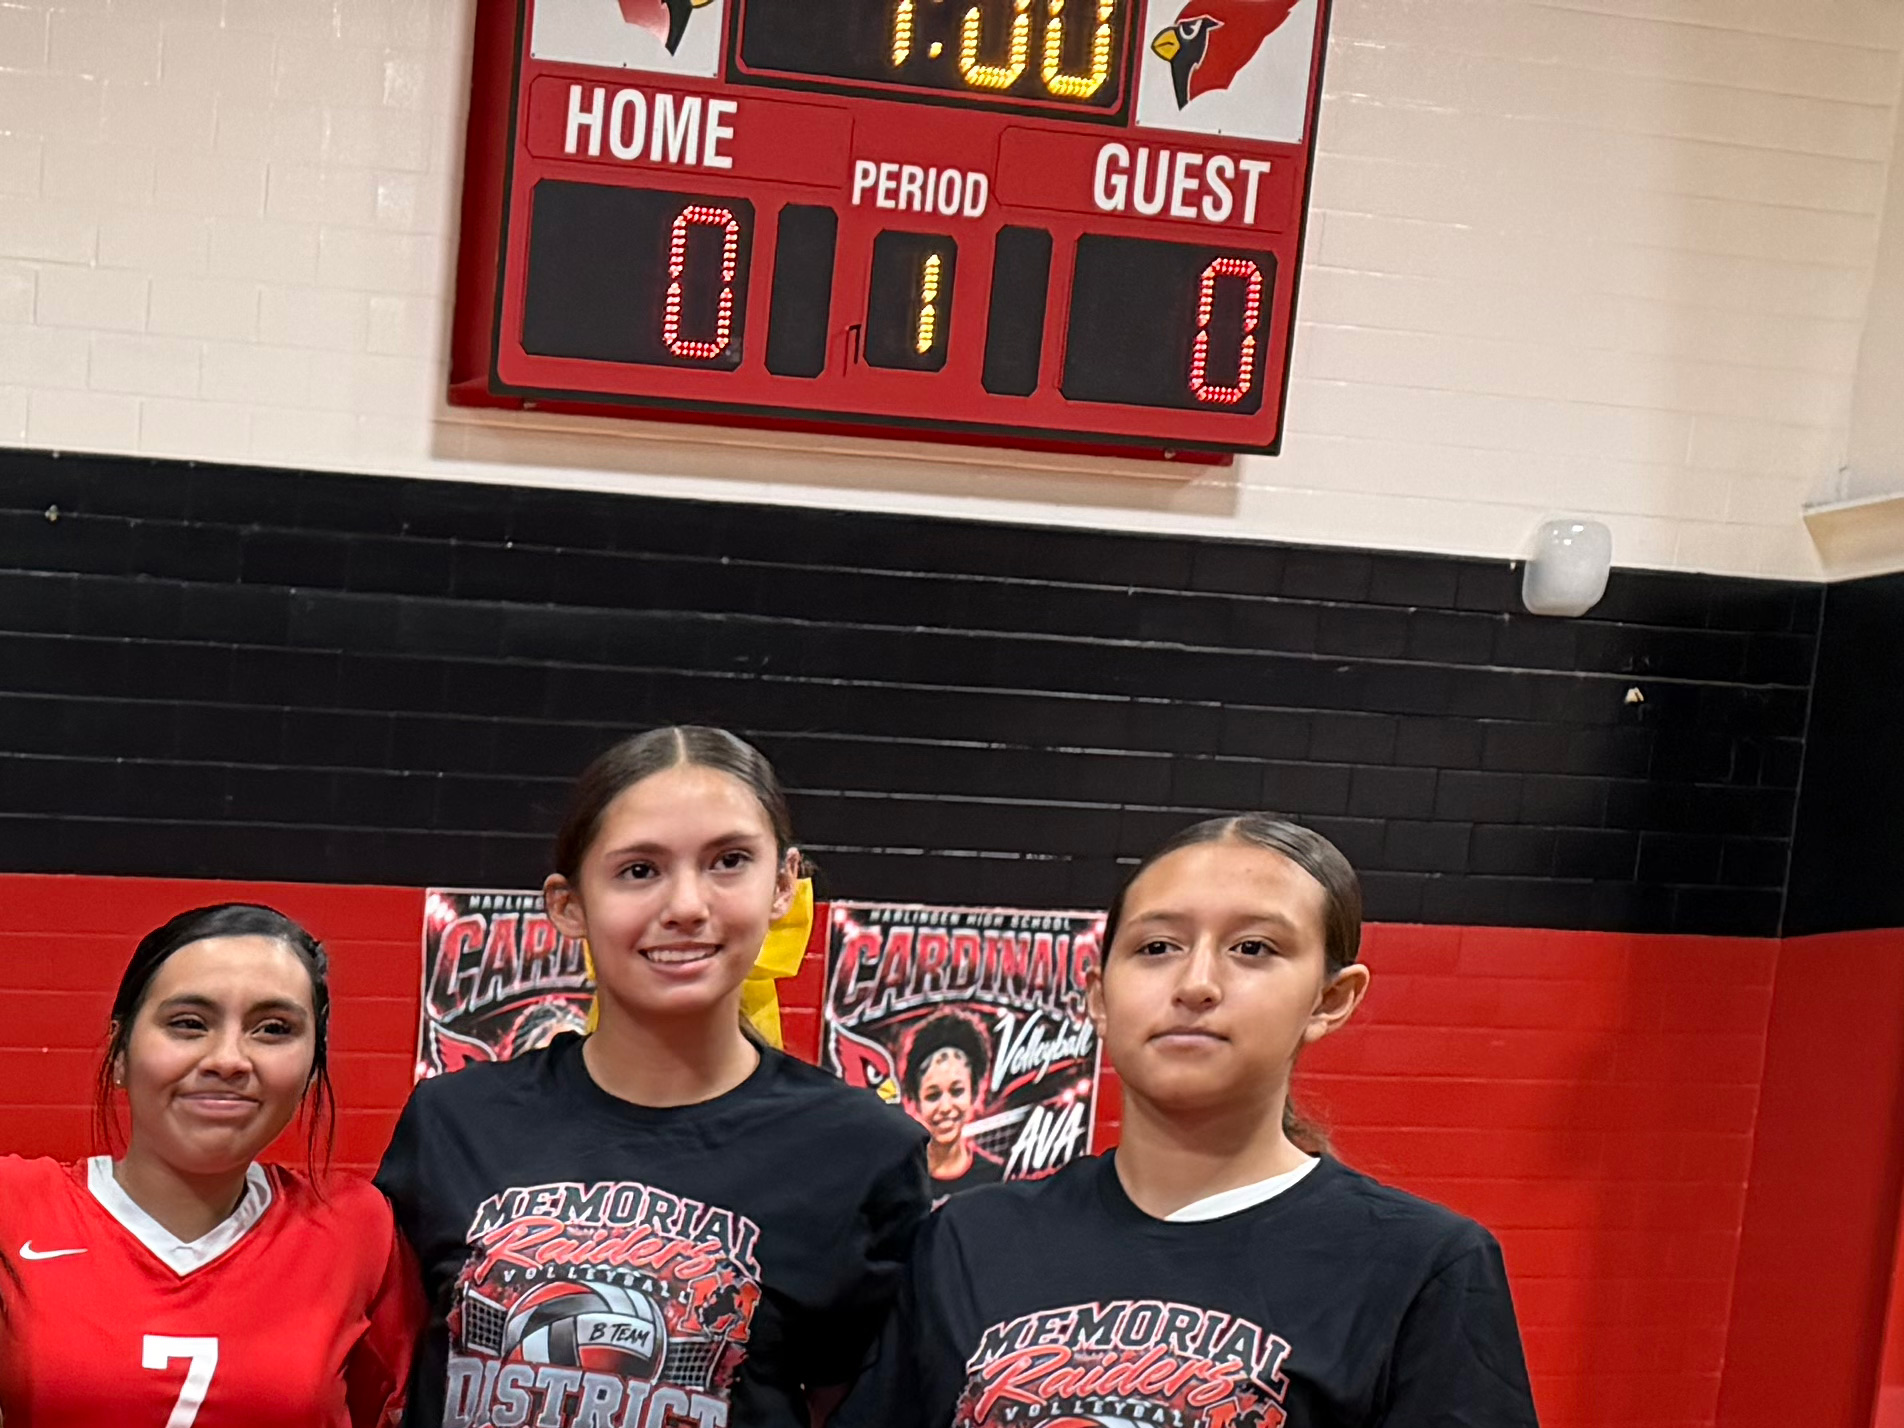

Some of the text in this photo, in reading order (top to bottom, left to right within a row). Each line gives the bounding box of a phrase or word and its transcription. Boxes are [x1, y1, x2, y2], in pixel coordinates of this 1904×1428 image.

[564, 84, 738, 170] HOME
[851, 159, 989, 219] PERIOD
[1092, 142, 1272, 225] GUEST
[661, 205, 739, 360] 0
[916, 251, 942, 357] 1
[1189, 256, 1263, 404] 0
[469, 895, 544, 910] HARLING
[825, 926, 1101, 1031] CARDINALS
[991, 1008, 1095, 1092] Volleyball
[1003, 1102, 1087, 1184] AVA
[466, 1182, 763, 1284] MEMORIAL
[474, 1216, 726, 1284] Raiders
[504, 1265, 689, 1304] VOLLEYBALL
[589, 1322, 651, 1348] B TEAM
[966, 1300, 1293, 1403] MEMORIAL
[974, 1344, 1248, 1425] Raiders
